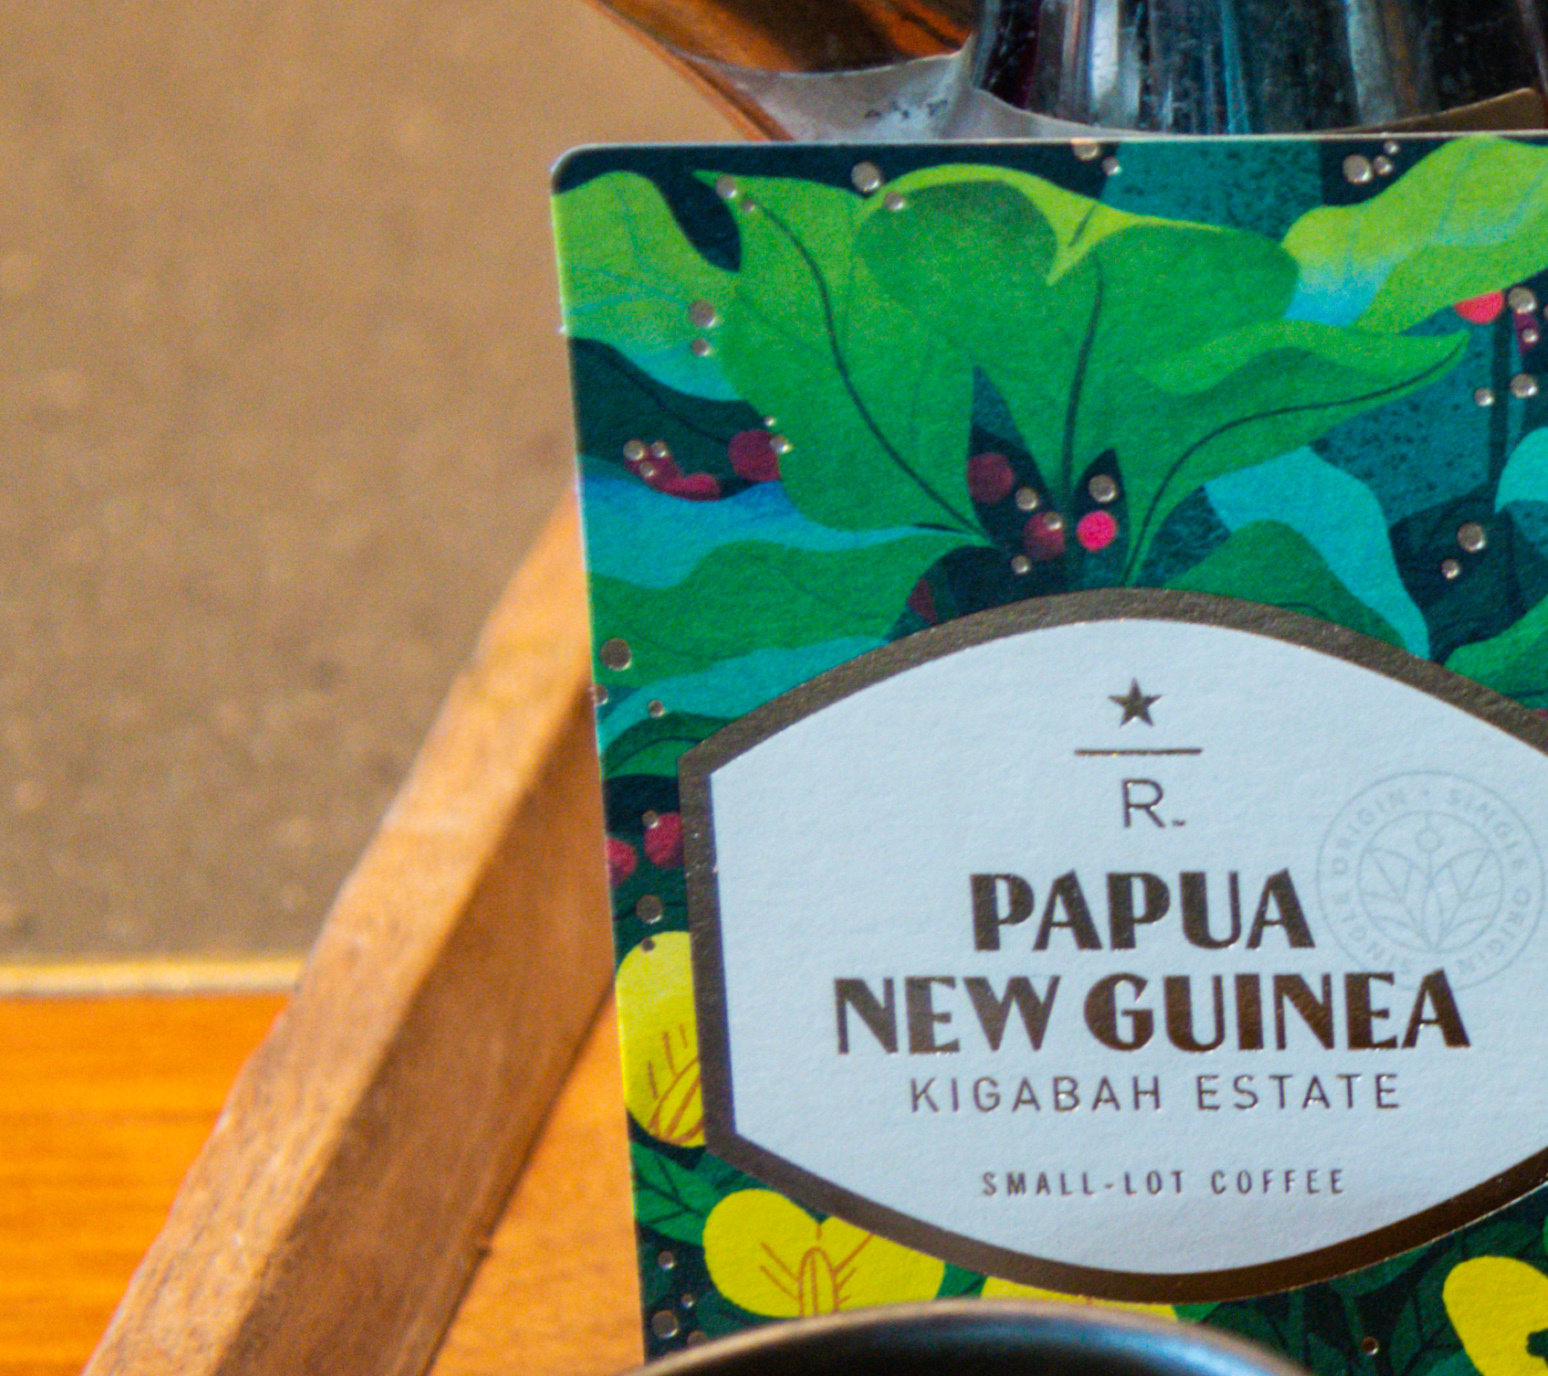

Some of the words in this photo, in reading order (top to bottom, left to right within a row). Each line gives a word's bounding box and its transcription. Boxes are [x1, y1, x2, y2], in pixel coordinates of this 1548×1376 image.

[1331, 791, 1405, 874] ORIGIN
[1450, 789, 1527, 870] SINGLE
[970, 868, 1316, 952] PAPUA
[834, 975, 1061, 1055] NEW
[1083, 968, 1471, 1054] GUINEA
[911, 1076, 1160, 1112] KIGABAH
[1196, 1073, 1399, 1111] ESTATE
[983, 1171, 1181, 1195] SMALL-LOT
[1211, 1169, 1342, 1194] COFFEE
